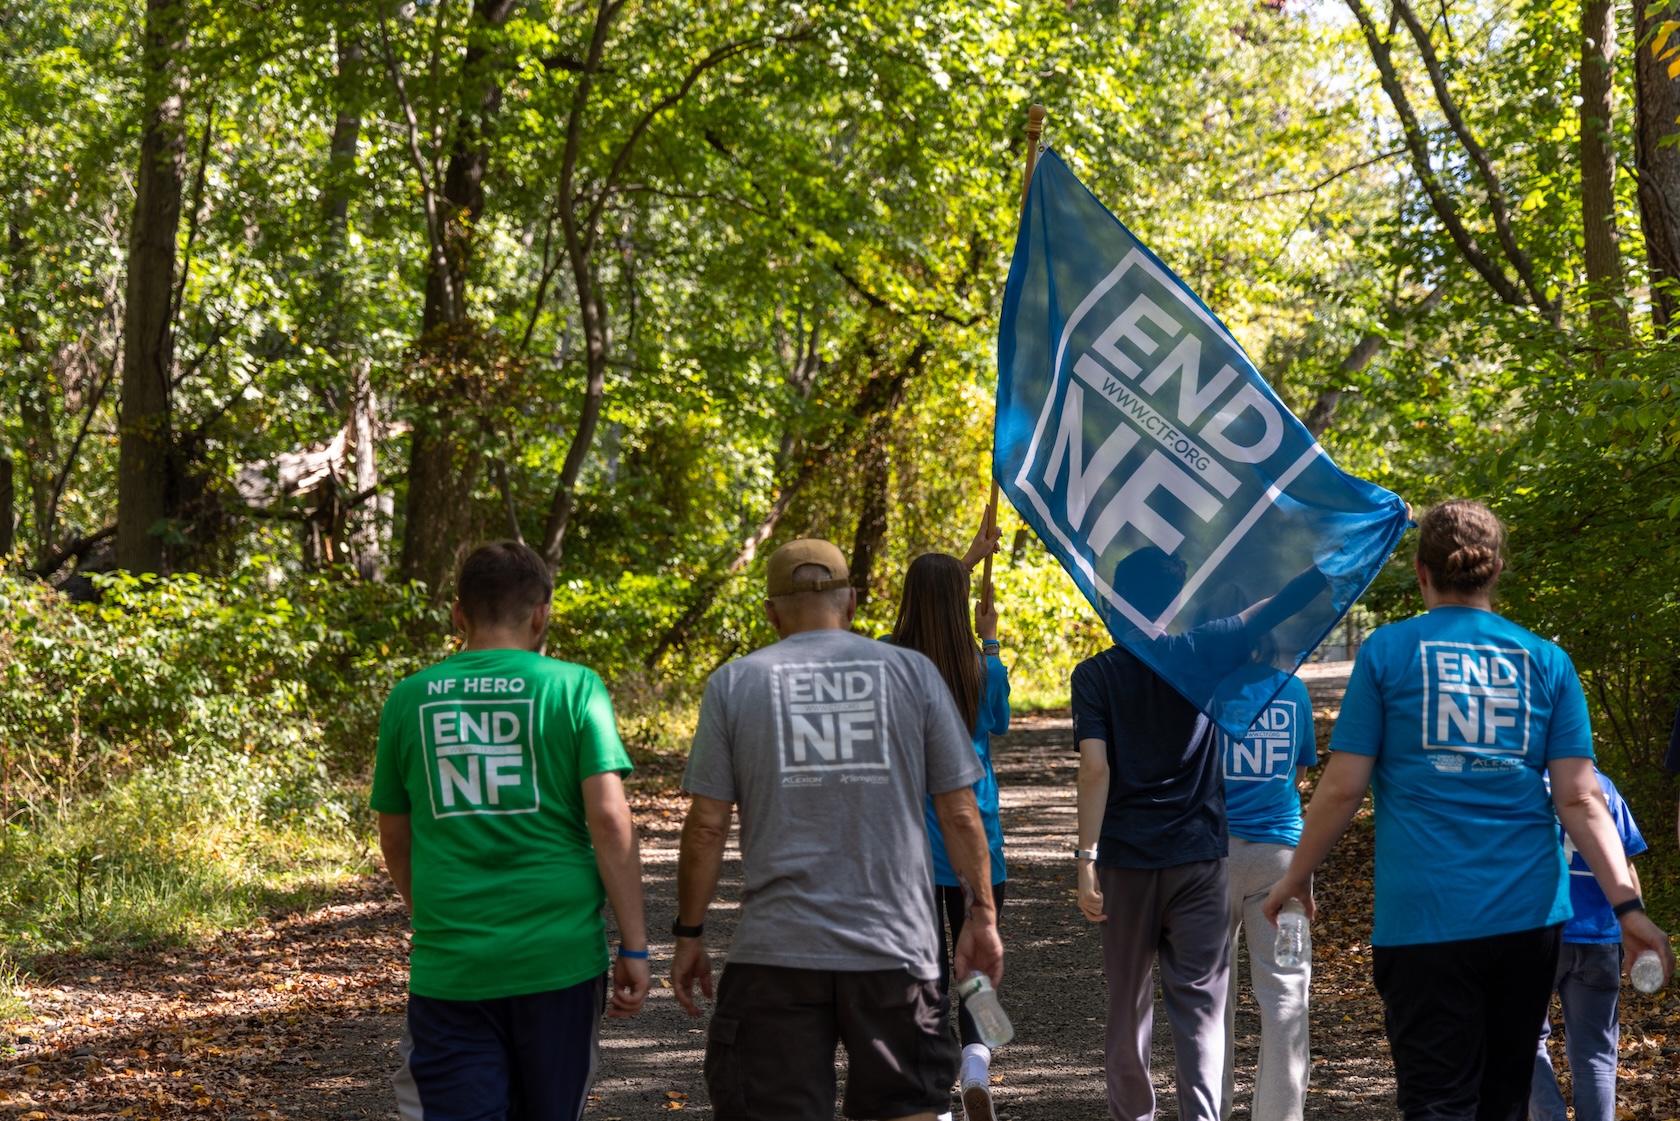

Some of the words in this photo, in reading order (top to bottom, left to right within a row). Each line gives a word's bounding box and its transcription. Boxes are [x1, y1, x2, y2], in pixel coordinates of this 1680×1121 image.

[1091, 293, 1284, 464] END
[1102, 377, 1210, 472] WWW.CTF.ORG
[1043, 378, 1224, 558] NF
[428, 679, 456, 696] NF
[464, 677, 525, 693] HERO
[788, 671, 874, 702] END
[1436, 651, 1519, 686] END
[432, 711, 521, 745] END
[790, 711, 875, 762] NF
[1249, 707, 1290, 731] ND
[1437, 693, 1519, 744] NF
[1233, 739, 1291, 774] NF
[437, 755, 523, 807] NF
